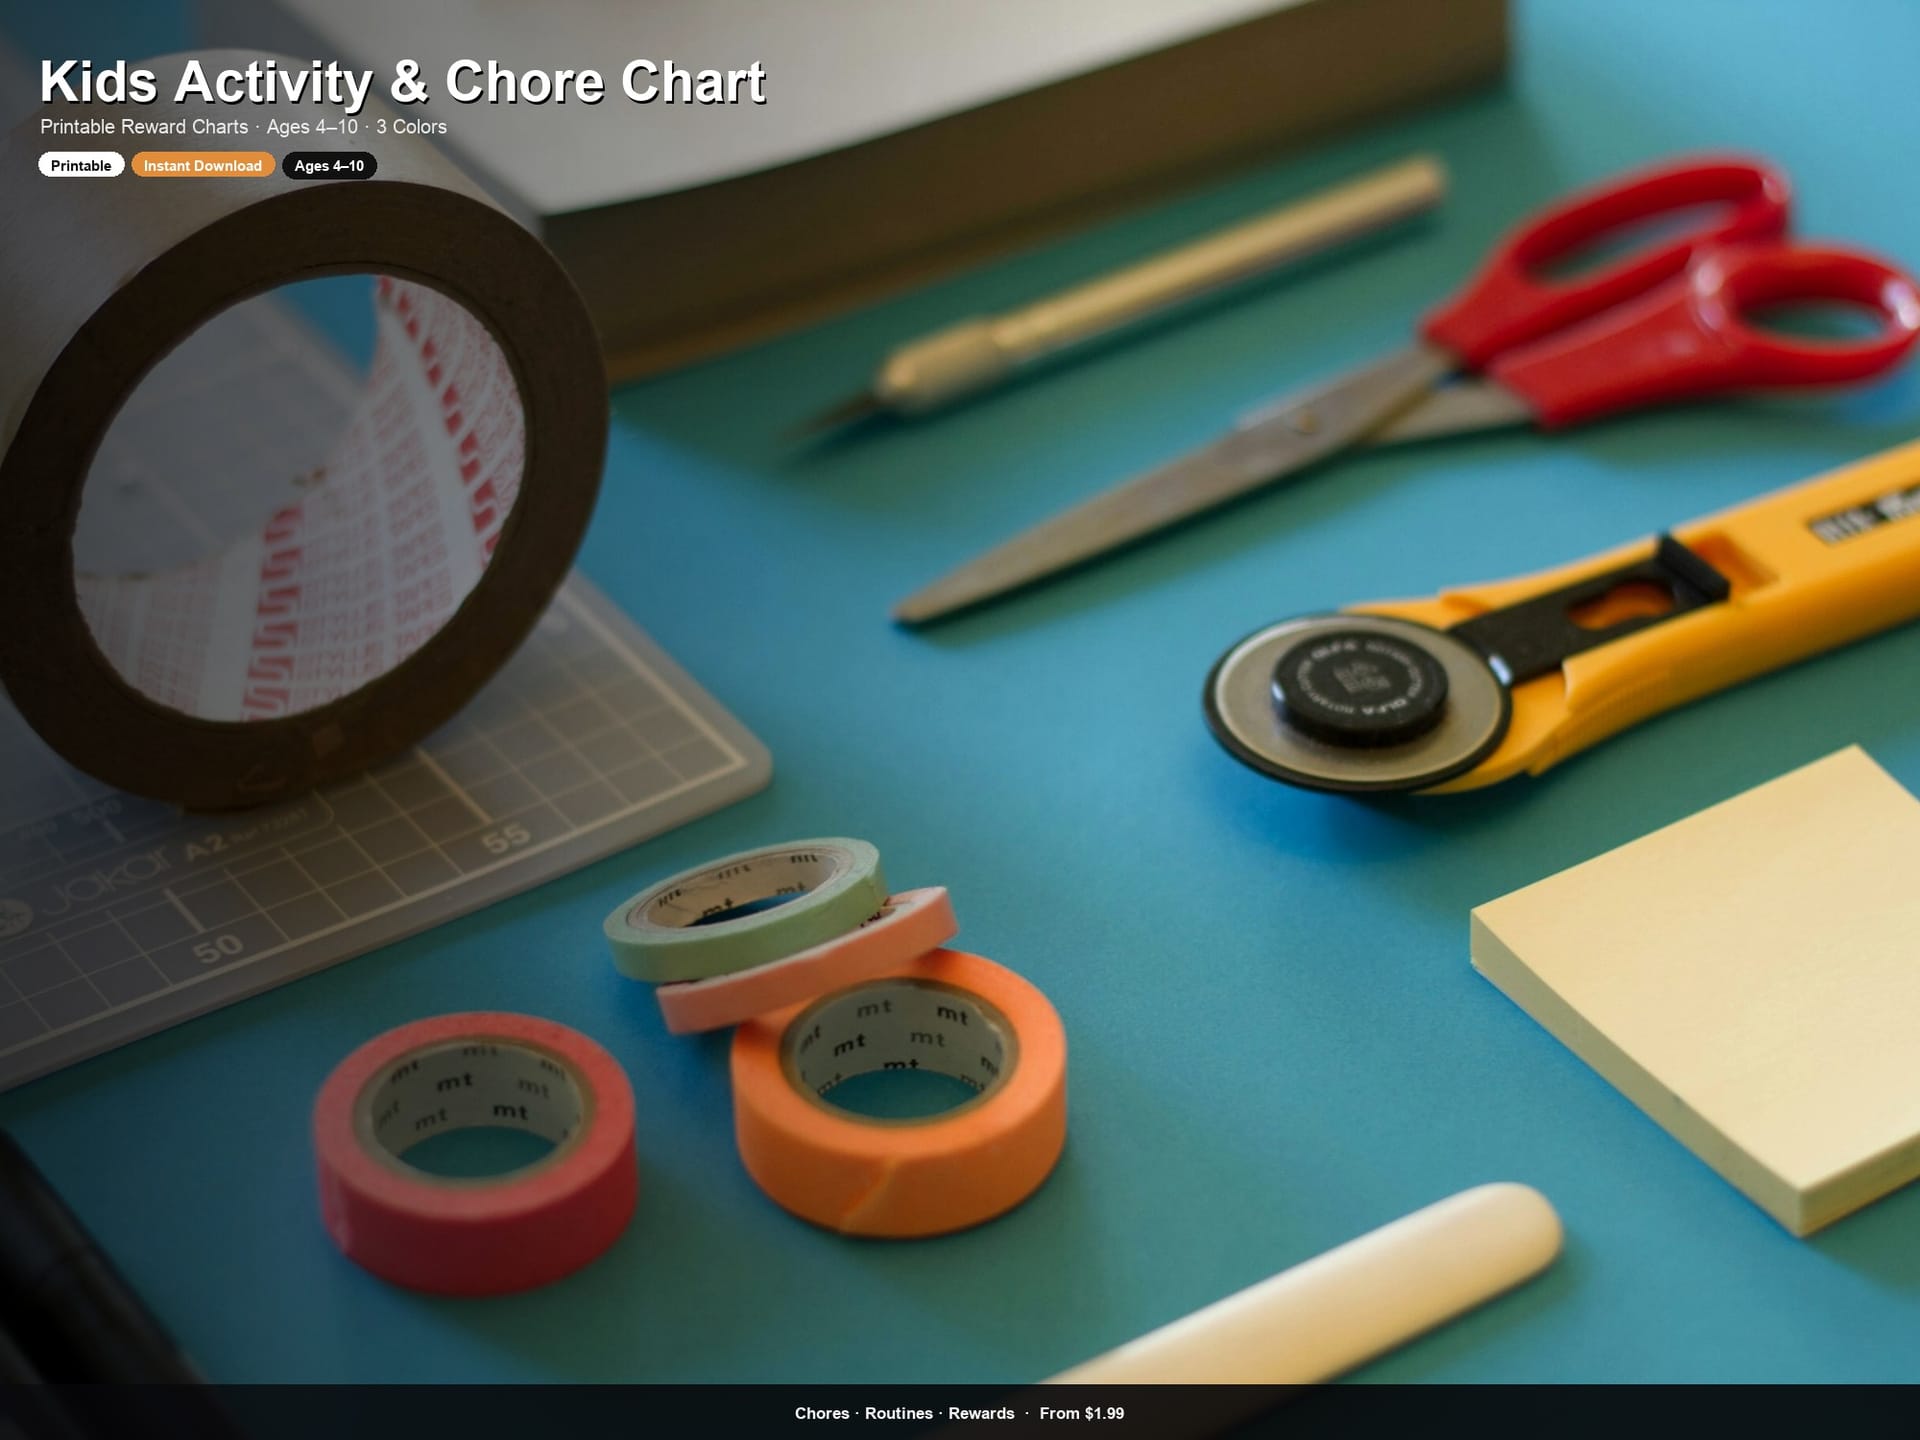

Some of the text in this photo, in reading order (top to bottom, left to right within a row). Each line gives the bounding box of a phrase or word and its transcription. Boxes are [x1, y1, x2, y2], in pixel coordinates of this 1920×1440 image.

[184, 833, 229, 863] A2
[482, 823, 530, 854] 55
[193, 935, 243, 963] 50
[856, 999, 893, 1018] mt
[936, 1006, 969, 1026] mt
[833, 1032, 867, 1058] mt
[910, 1030, 946, 1047] mt
[883, 1059, 919, 1070] mt
[436, 1071, 473, 1093] mt
[517, 1079, 551, 1100] mt
[415, 1107, 449, 1131] mt
[492, 1104, 528, 1121] mt
